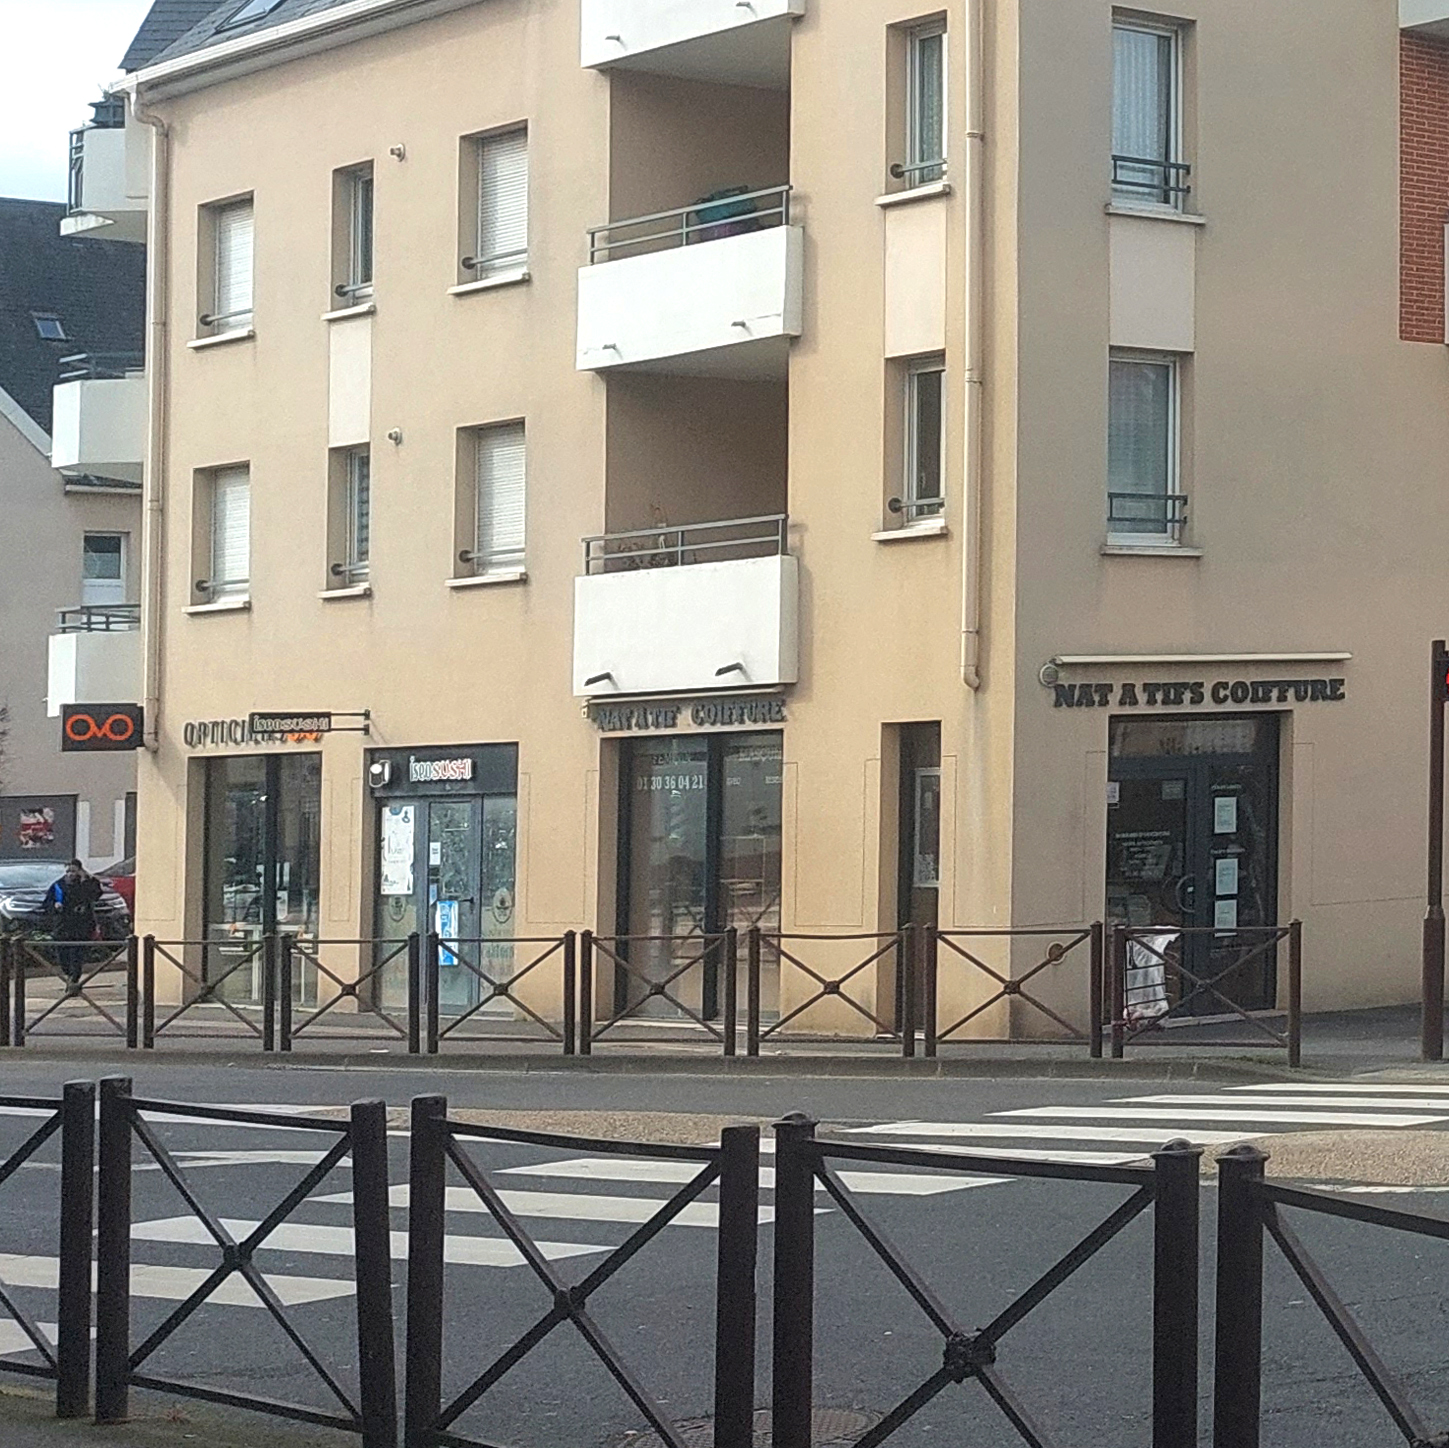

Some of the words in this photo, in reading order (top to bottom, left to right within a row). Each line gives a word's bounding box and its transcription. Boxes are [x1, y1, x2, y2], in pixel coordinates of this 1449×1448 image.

[1053, 683, 1114, 708] NAT
[1118, 683, 1140, 707] A
[1211, 678, 1346, 705] COIFFURE
[690, 698, 788, 726] COIFFURE
[650, 775, 662, 790] 30
[664, 774, 676, 790] 36
[678, 774, 690, 789] 04
[692, 773, 704, 789] 21
